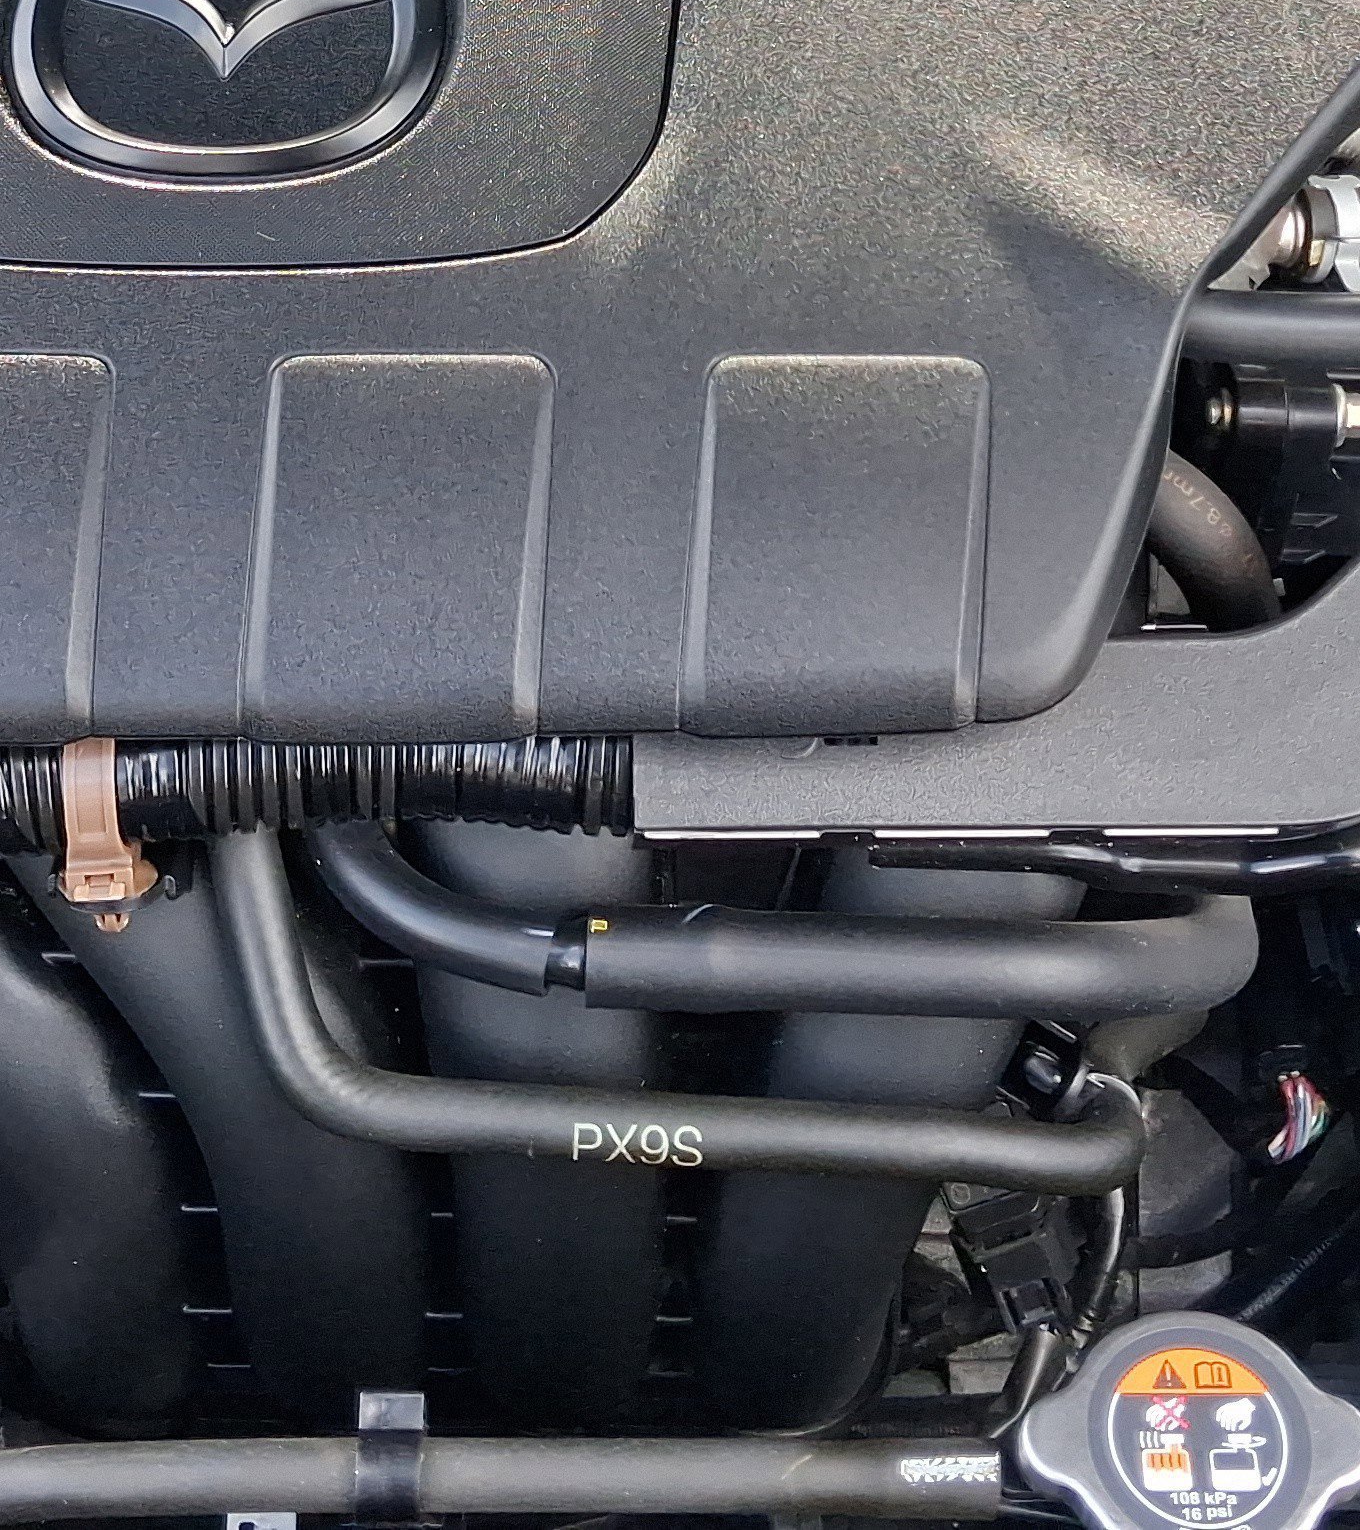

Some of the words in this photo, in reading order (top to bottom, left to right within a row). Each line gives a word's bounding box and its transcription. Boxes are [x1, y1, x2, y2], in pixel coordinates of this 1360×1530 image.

[572, 1122, 703, 1167] PX9S
[1169, 1491, 1200, 1505] 108
[1204, 1491, 1237, 1505] kPa
[1181, 1507, 1202, 1521] 16
[1206, 1504, 1233, 1521] psi
